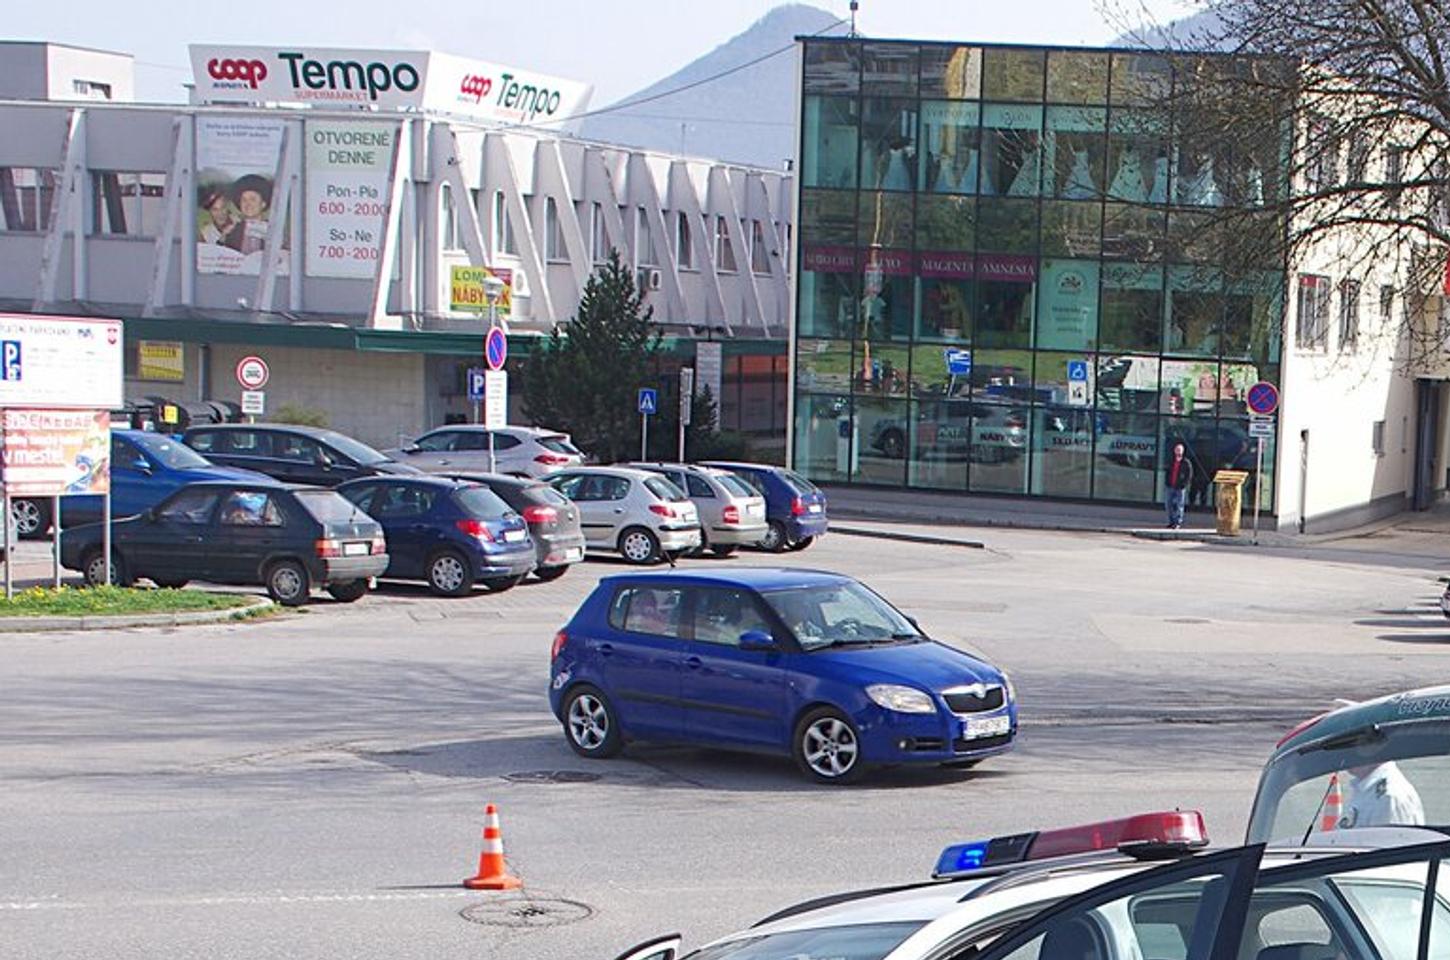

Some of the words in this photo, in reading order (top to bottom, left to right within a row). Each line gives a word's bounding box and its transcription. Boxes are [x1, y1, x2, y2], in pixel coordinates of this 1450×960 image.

[278, 52, 419, 100] Tempo
[498, 73, 561, 122] Tempo
[313, 130, 390, 147] OTVORENÉ
[328, 152, 376, 165] DENNE
[326, 185, 350, 198] Pon
[329, 229, 346, 242] So
[355, 230, 373, 243] Ne
